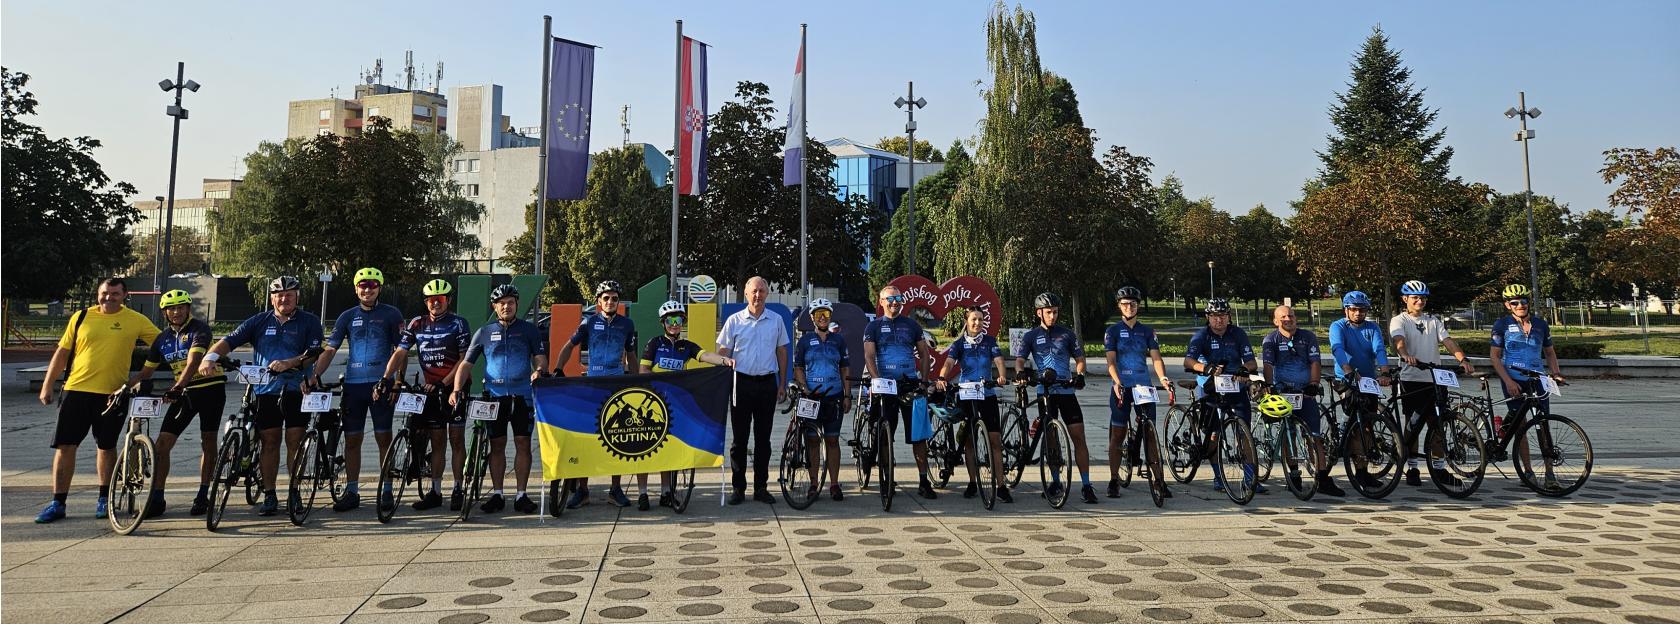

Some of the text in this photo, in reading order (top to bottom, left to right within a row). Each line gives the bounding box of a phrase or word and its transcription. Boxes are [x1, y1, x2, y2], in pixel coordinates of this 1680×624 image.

[899, 285, 938, 314] onjskog
[943, 284, 972, 309] polja
[611, 431, 659, 443] KUTINA
